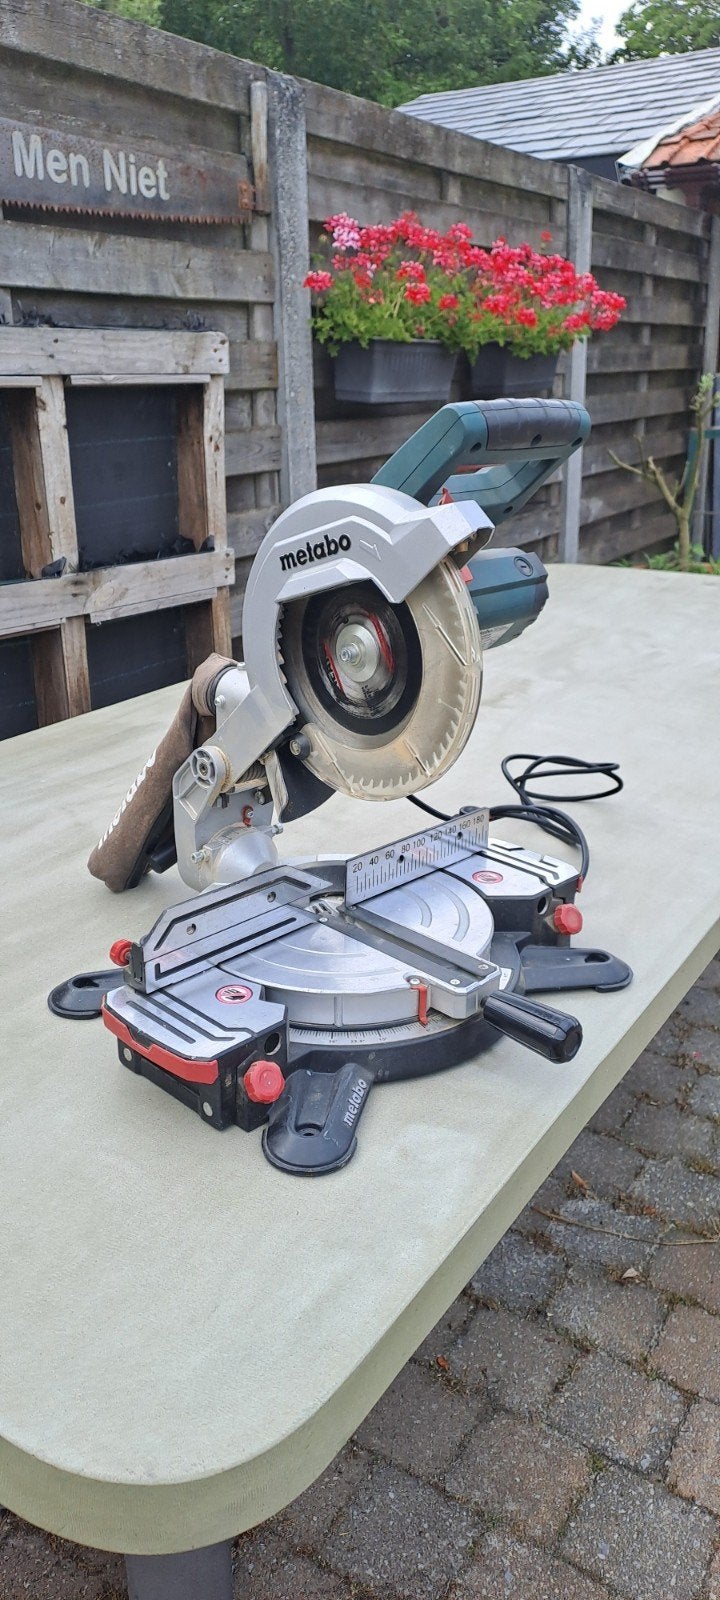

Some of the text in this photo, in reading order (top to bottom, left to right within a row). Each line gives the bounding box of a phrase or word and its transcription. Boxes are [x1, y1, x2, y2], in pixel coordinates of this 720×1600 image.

[12, 130, 170, 200] Men Niet
[280, 533, 351, 571] metabo
[352, 814, 485, 873] 20 40 60 80 100 120 140 160 180
[343, 1078, 368, 1127] metabo
